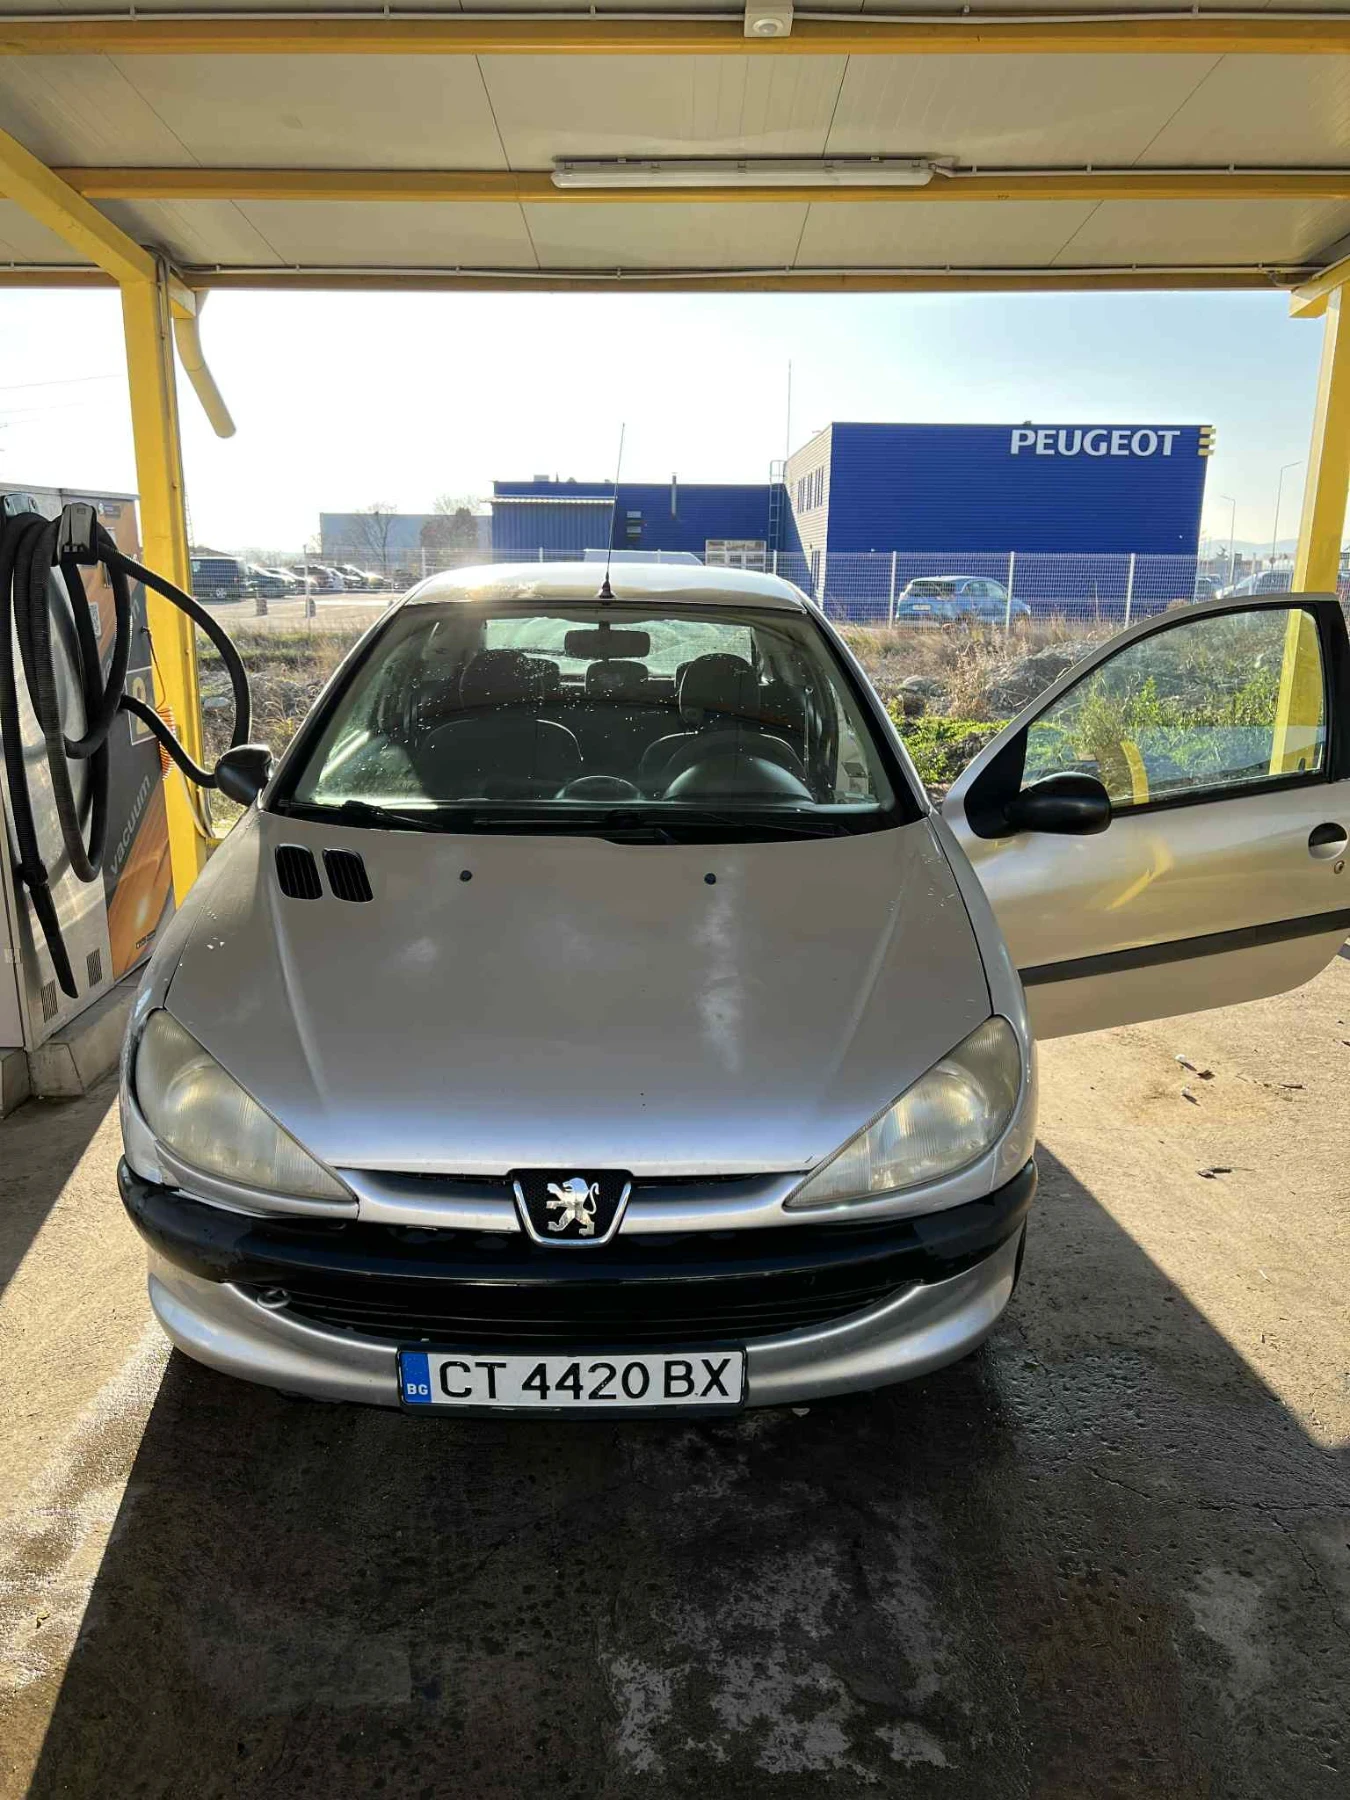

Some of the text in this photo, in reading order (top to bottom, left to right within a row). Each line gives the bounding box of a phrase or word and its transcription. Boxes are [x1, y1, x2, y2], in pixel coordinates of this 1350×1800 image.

[1010, 429, 1181, 456] PEUGEOT
[110, 775, 151, 874] vacuum
[407, 1383, 429, 1396] BG
[439, 1358, 731, 1400] CT 4420 BX
